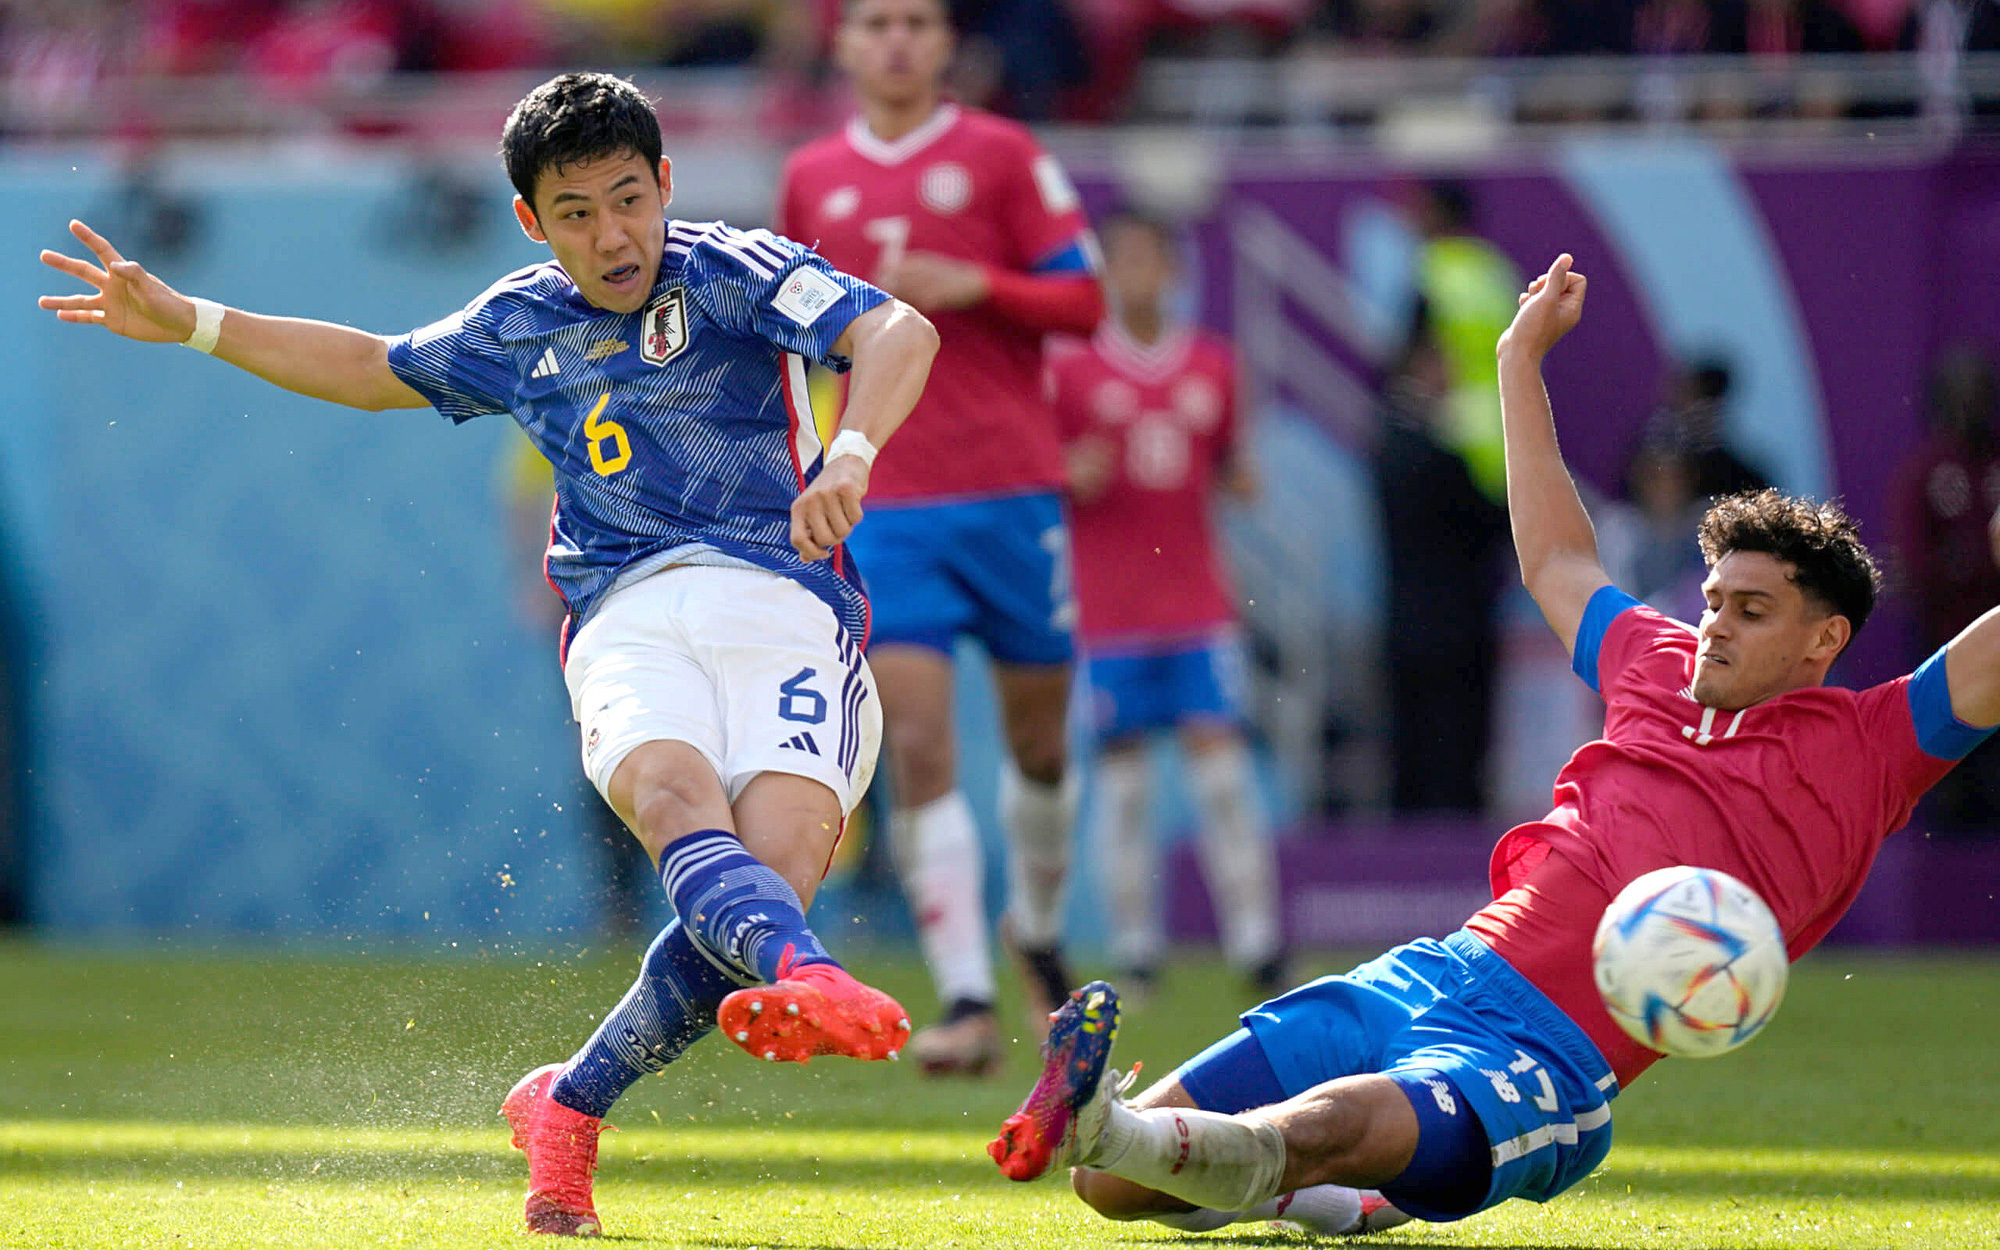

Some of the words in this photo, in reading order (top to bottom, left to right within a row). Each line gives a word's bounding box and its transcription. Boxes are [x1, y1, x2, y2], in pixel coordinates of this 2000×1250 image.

[652, 293, 672, 308] JAPAN
[584, 393, 632, 476] 6
[778, 666, 827, 725] 6
[1507, 1049, 1559, 1112] 17
